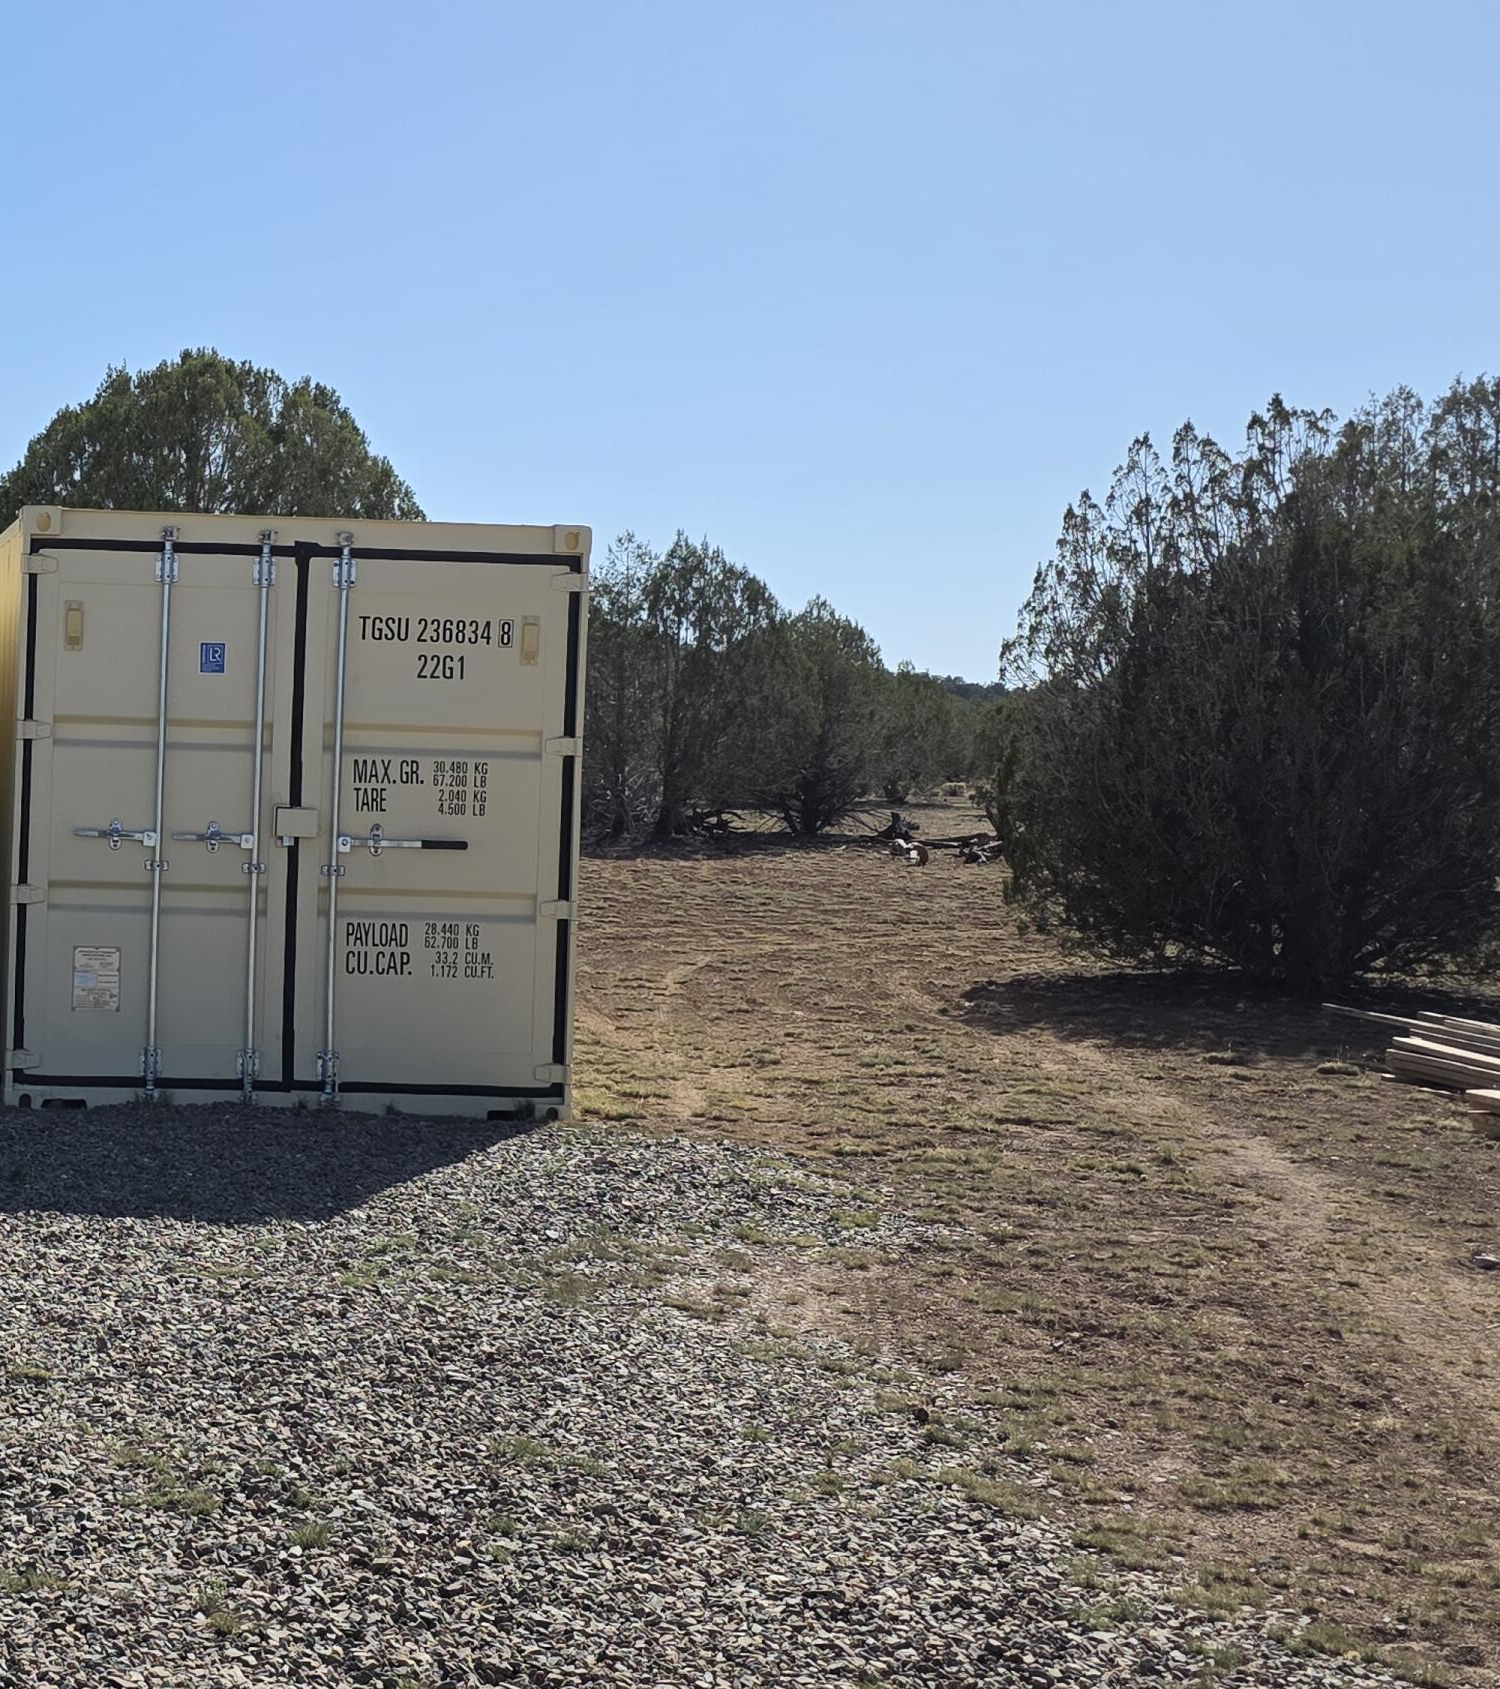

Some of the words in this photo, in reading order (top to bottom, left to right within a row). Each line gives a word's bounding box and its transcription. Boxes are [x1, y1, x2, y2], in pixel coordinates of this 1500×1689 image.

[359, 615, 410, 642] TGSU
[416, 617, 492, 646] 236834
[500, 620, 512, 646] 8
[417, 654, 465, 680] 22G1
[433, 760, 469, 774] 30.480
[474, 762, 489, 775] KG
[432, 774, 468, 788] 67.200
[473, 775, 487, 788] LB
[353, 787, 387, 813] TARE
[438, 789, 467, 803] 2.040
[473, 790, 487, 804] KG
[437, 803, 466, 816] 4.500
[472, 803, 486, 817] LB
[346, 922, 409, 948] PAYLOAD
[424, 922, 460, 936] 28.440
[465, 924, 480, 937] KG
[424, 936, 459, 950] 62.700
[465, 937, 478, 950] LB
[345, 950, 412, 976] CU.CAP.
[435, 951, 458, 965] 33.2
[464, 952, 494, 966] CU.M.
[430, 964, 458, 978] 1.172
[464, 965, 494, 979] CU.FT.
